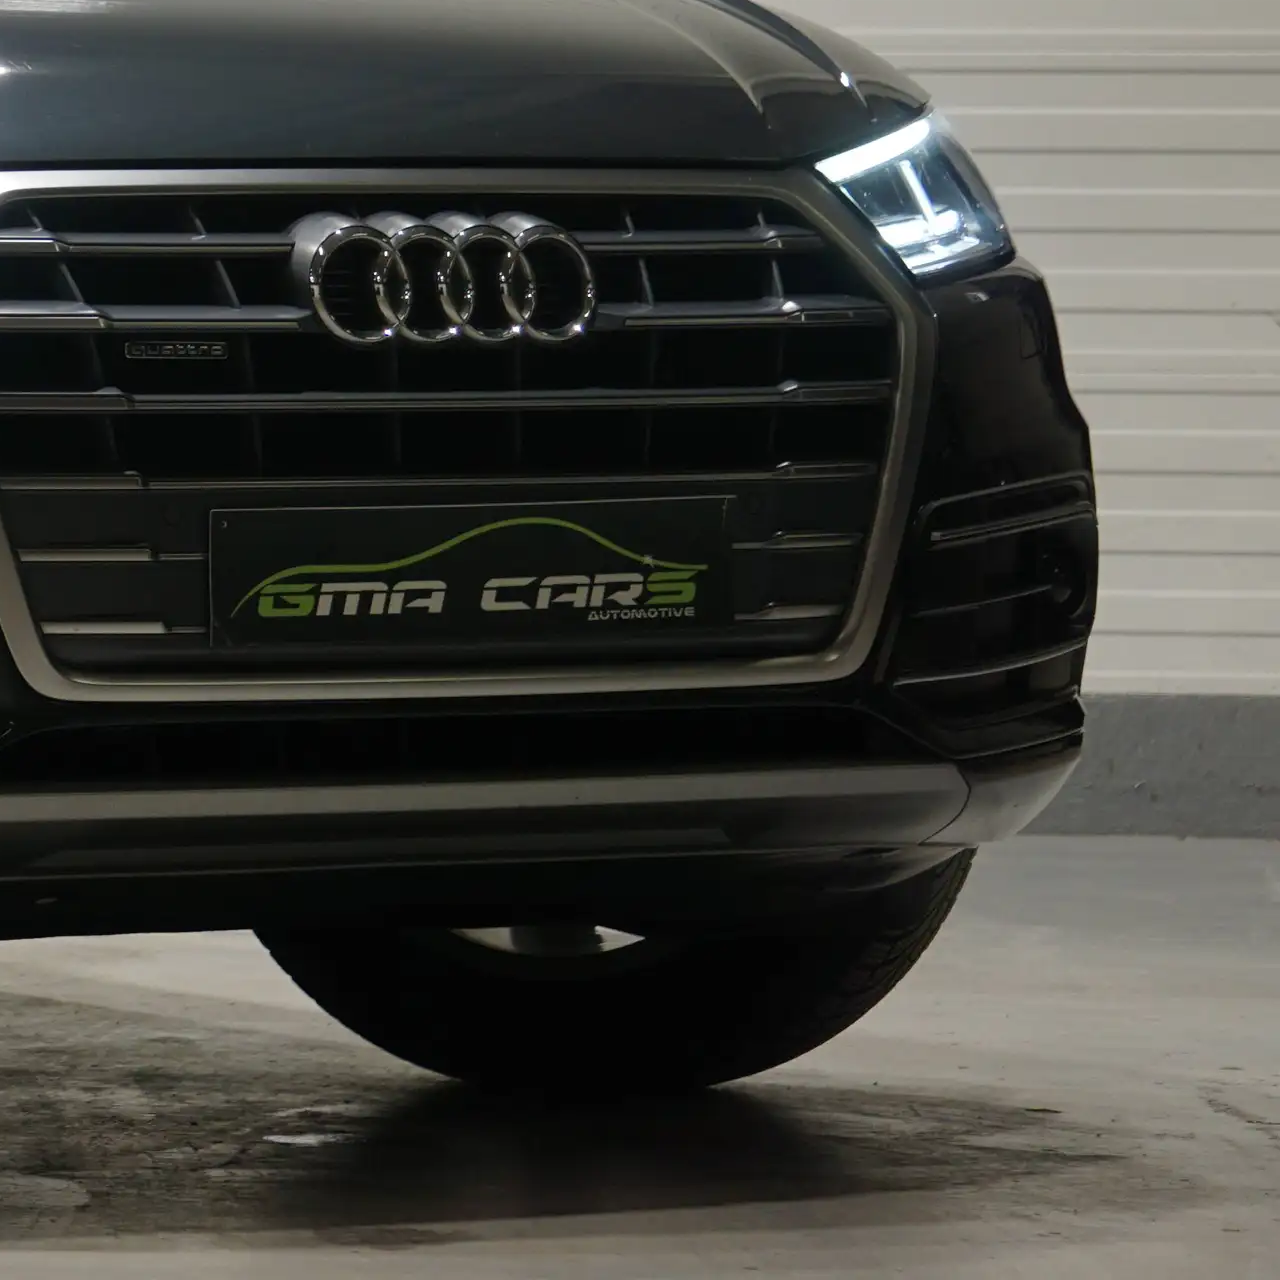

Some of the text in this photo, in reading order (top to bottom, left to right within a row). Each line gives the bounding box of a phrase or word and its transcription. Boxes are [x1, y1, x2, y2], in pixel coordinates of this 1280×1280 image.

[257, 569, 700, 618] GMA CARS
[587, 606, 696, 621] AUTOMOTIVE
